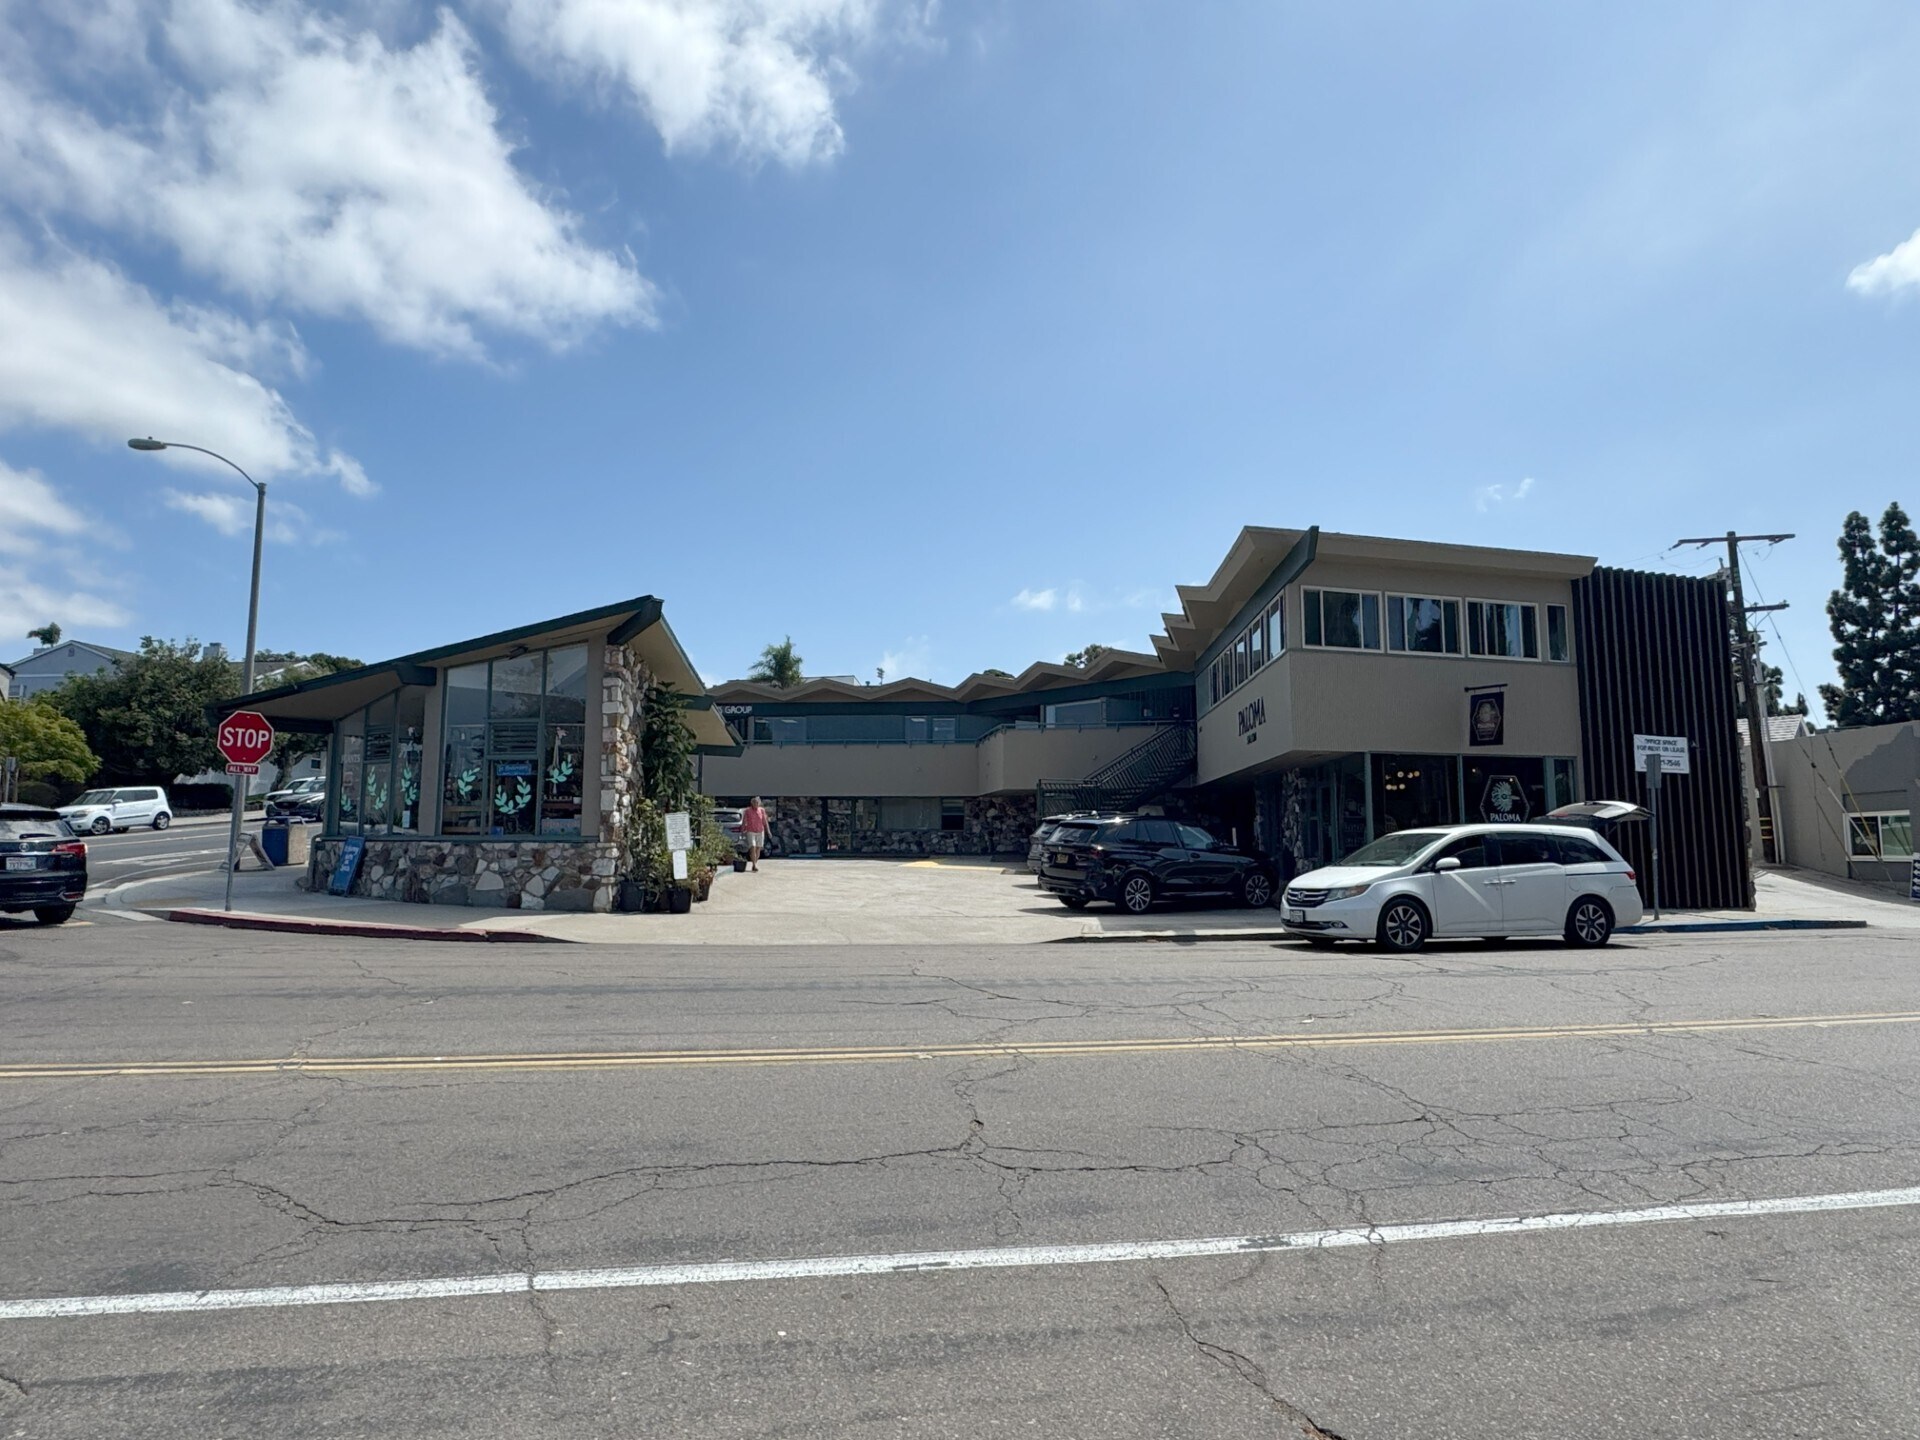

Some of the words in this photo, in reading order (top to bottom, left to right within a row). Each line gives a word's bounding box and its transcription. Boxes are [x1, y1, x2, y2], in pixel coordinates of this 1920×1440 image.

[724, 705, 753, 714] GROUP
[1238, 696, 1266, 736] PALOMA
[222, 727, 270, 748] STOP
[1490, 812, 1521, 822] PALOMA
